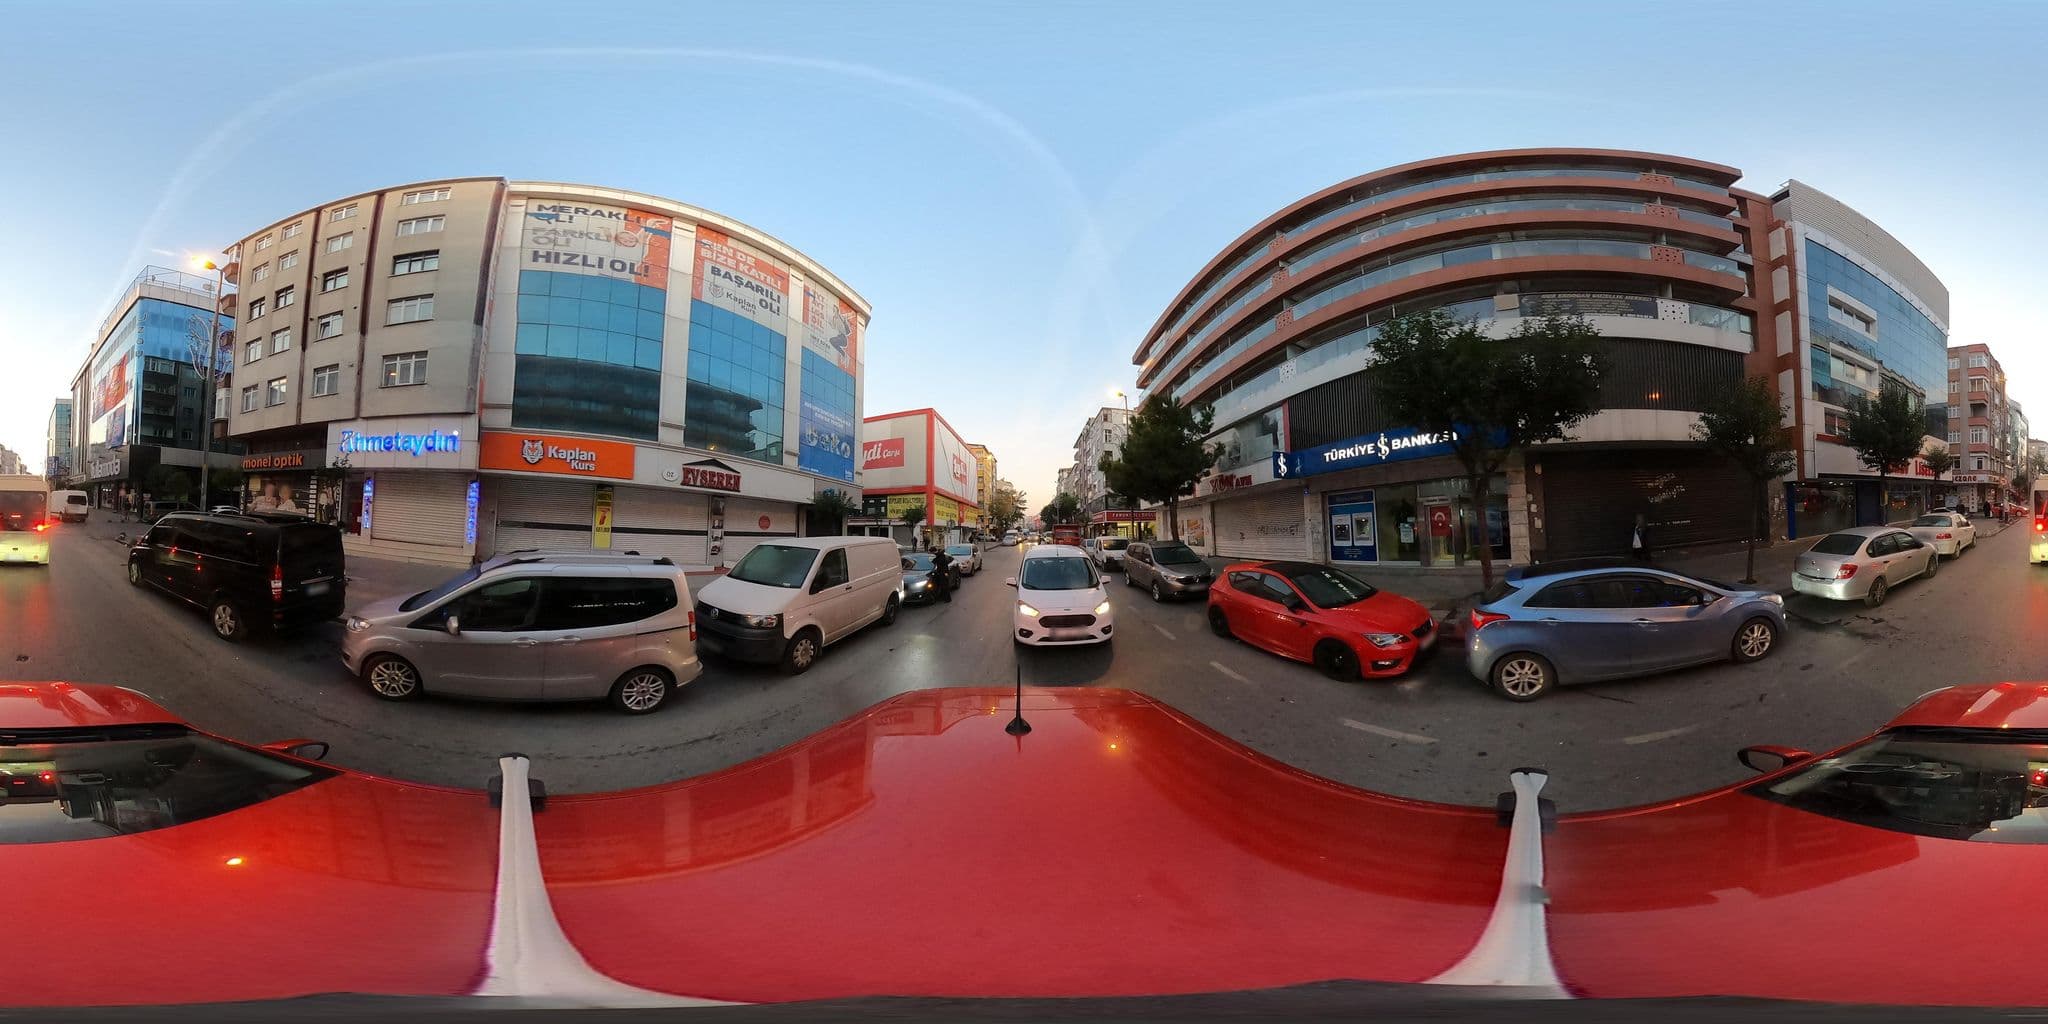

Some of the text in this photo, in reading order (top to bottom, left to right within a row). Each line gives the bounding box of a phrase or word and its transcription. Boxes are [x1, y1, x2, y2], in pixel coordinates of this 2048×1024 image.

[532, 250, 650, 277] HIZLI OL!
[711, 265, 781, 304] BAŞARILI
[726, 291, 757, 310] Kaplan
[759, 298, 780, 316] OL!
[273, 452, 303, 468] optik
[548, 445, 596, 463] Kaplan
[1323, 443, 1375, 463] TÜRKİYE
[571, 460, 596, 471] Kurs
[682, 467, 741, 491] EVSEREN
